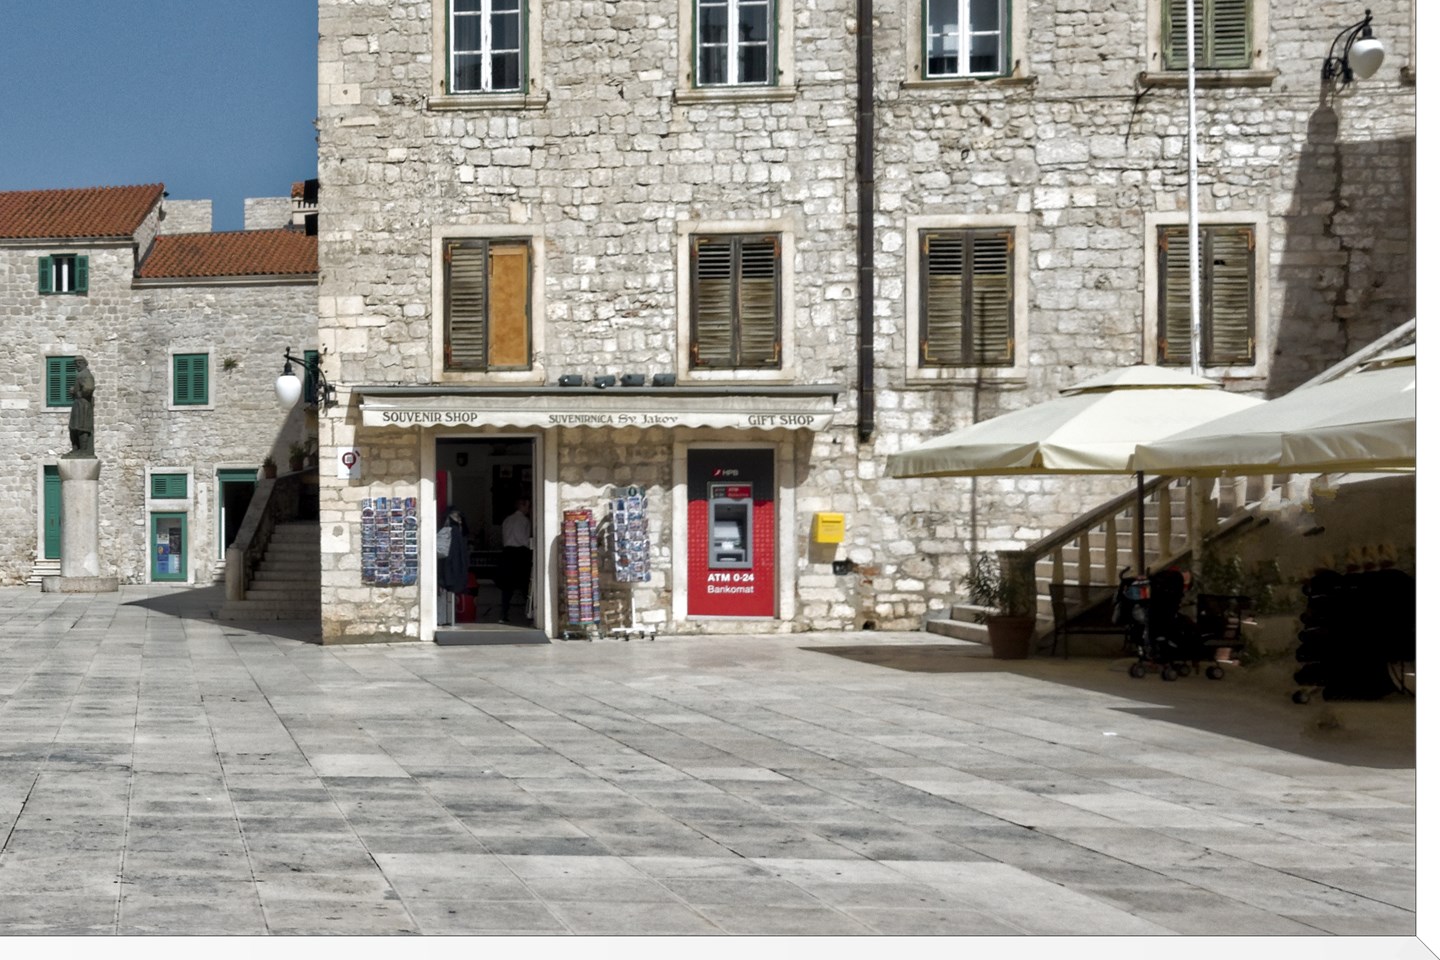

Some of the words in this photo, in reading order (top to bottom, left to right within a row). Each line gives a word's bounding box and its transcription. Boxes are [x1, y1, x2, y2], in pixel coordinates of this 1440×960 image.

[382, 411, 442, 422] SOUVENIR
[445, 412, 478, 423] SHOP
[748, 415, 776, 426] GIFT
[779, 415, 814, 426] SHOP
[707, 573, 730, 582] ATM
[733, 573, 754, 582] 0-24
[707, 585, 754, 594] Bankomat
